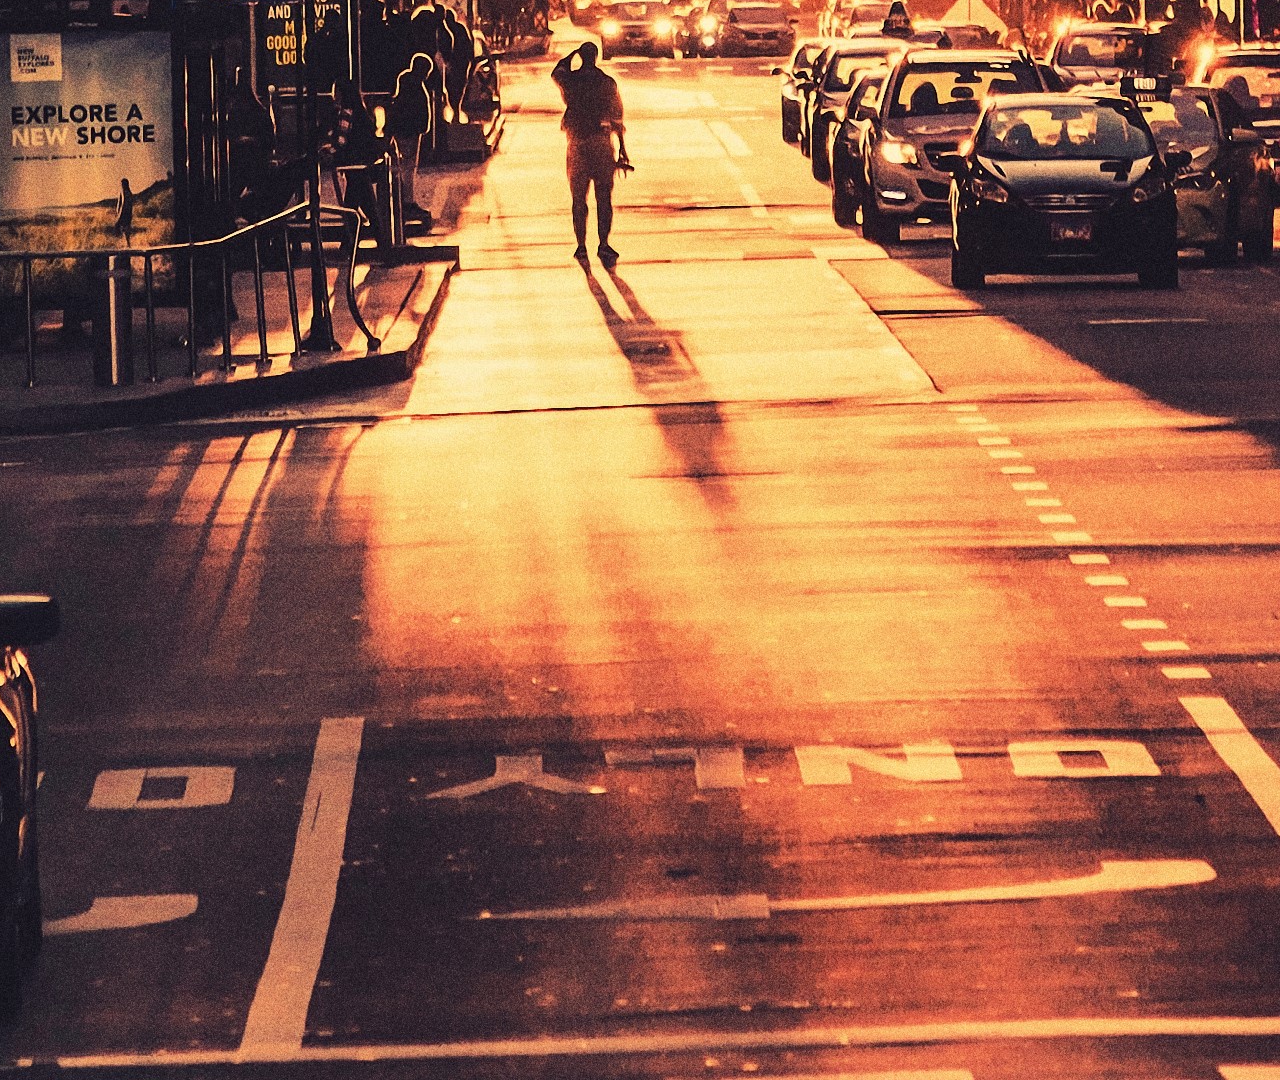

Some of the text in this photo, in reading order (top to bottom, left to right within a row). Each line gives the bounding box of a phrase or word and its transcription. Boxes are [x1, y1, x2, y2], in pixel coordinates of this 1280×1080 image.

[267, 4, 291, 19] AND
[266, 35, 297, 50] GOOD
[276, 50, 297, 65] LOO
[11, 103, 143, 125] EXPLORE A
[11, 125, 156, 148] NEW SHORE
